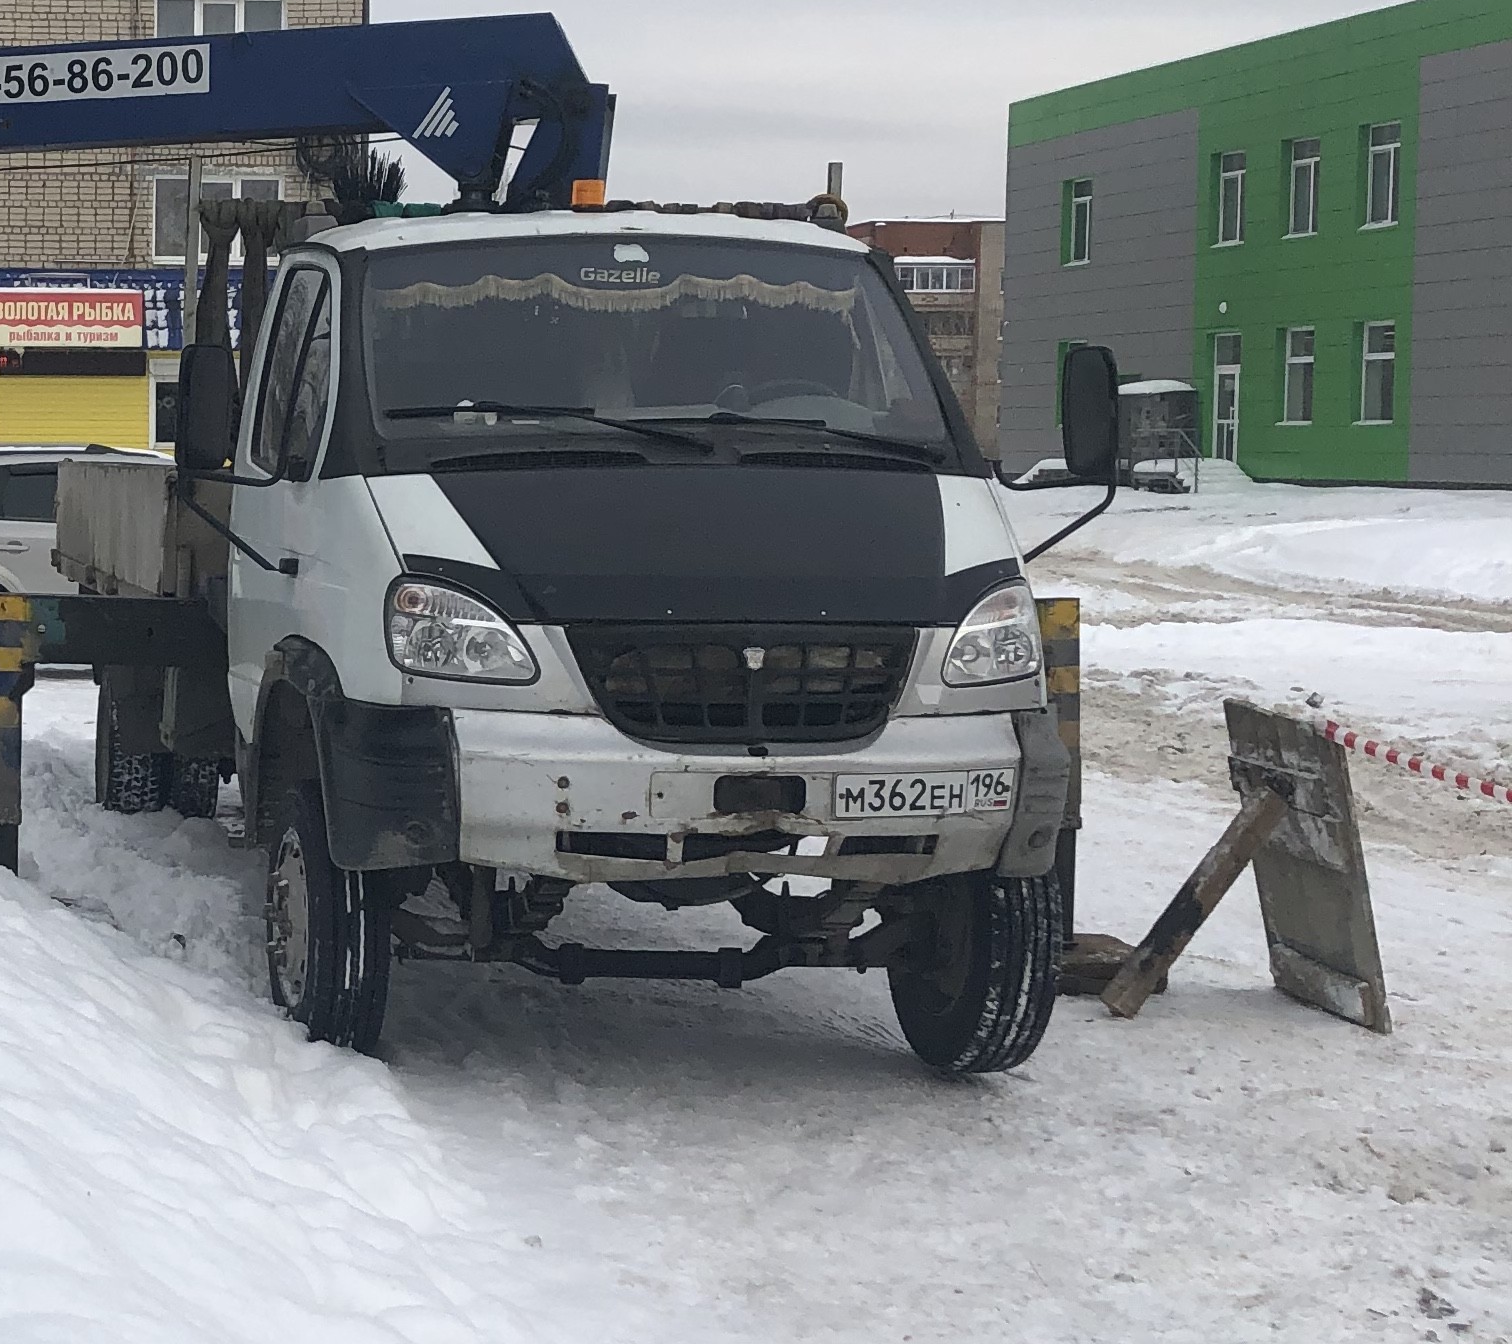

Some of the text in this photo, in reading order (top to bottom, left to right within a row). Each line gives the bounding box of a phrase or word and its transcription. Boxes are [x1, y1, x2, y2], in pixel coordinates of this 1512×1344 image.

[580, 267, 661, 284] Gazelle
[72, 302, 134, 321] РЫБКА
[9, 329, 118, 343] рыбалка и туризм
[844, 771, 1006, 813] М362ЕН 196
[974, 798, 993, 808] RUS
